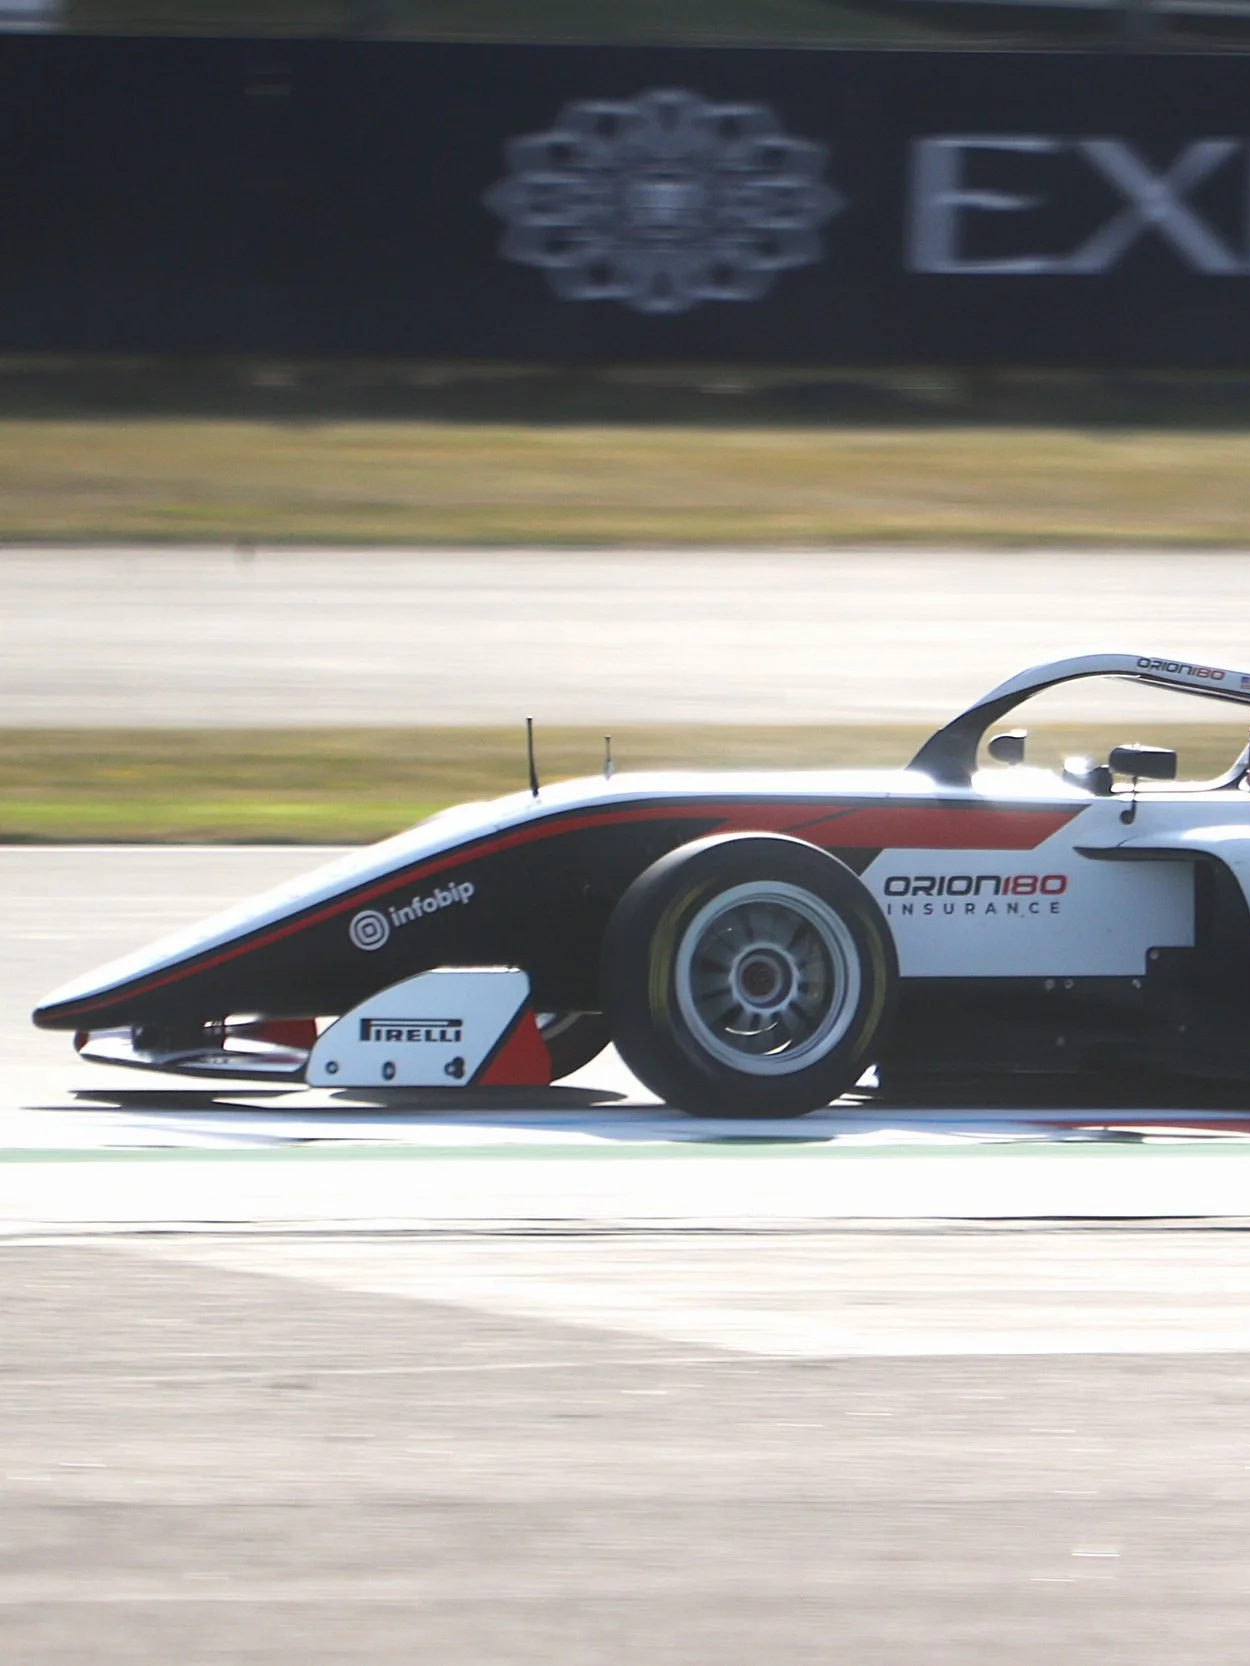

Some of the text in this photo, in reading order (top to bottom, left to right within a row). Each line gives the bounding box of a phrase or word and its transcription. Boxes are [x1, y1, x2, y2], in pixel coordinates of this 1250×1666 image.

[1136, 657, 1226, 681] ORION180
[883, 874, 1068, 897] ORION180
[388, 881, 475, 928] infobip
[886, 901, 1061, 916] INSURANCE
[359, 1018, 464, 1043] PIRELLI
